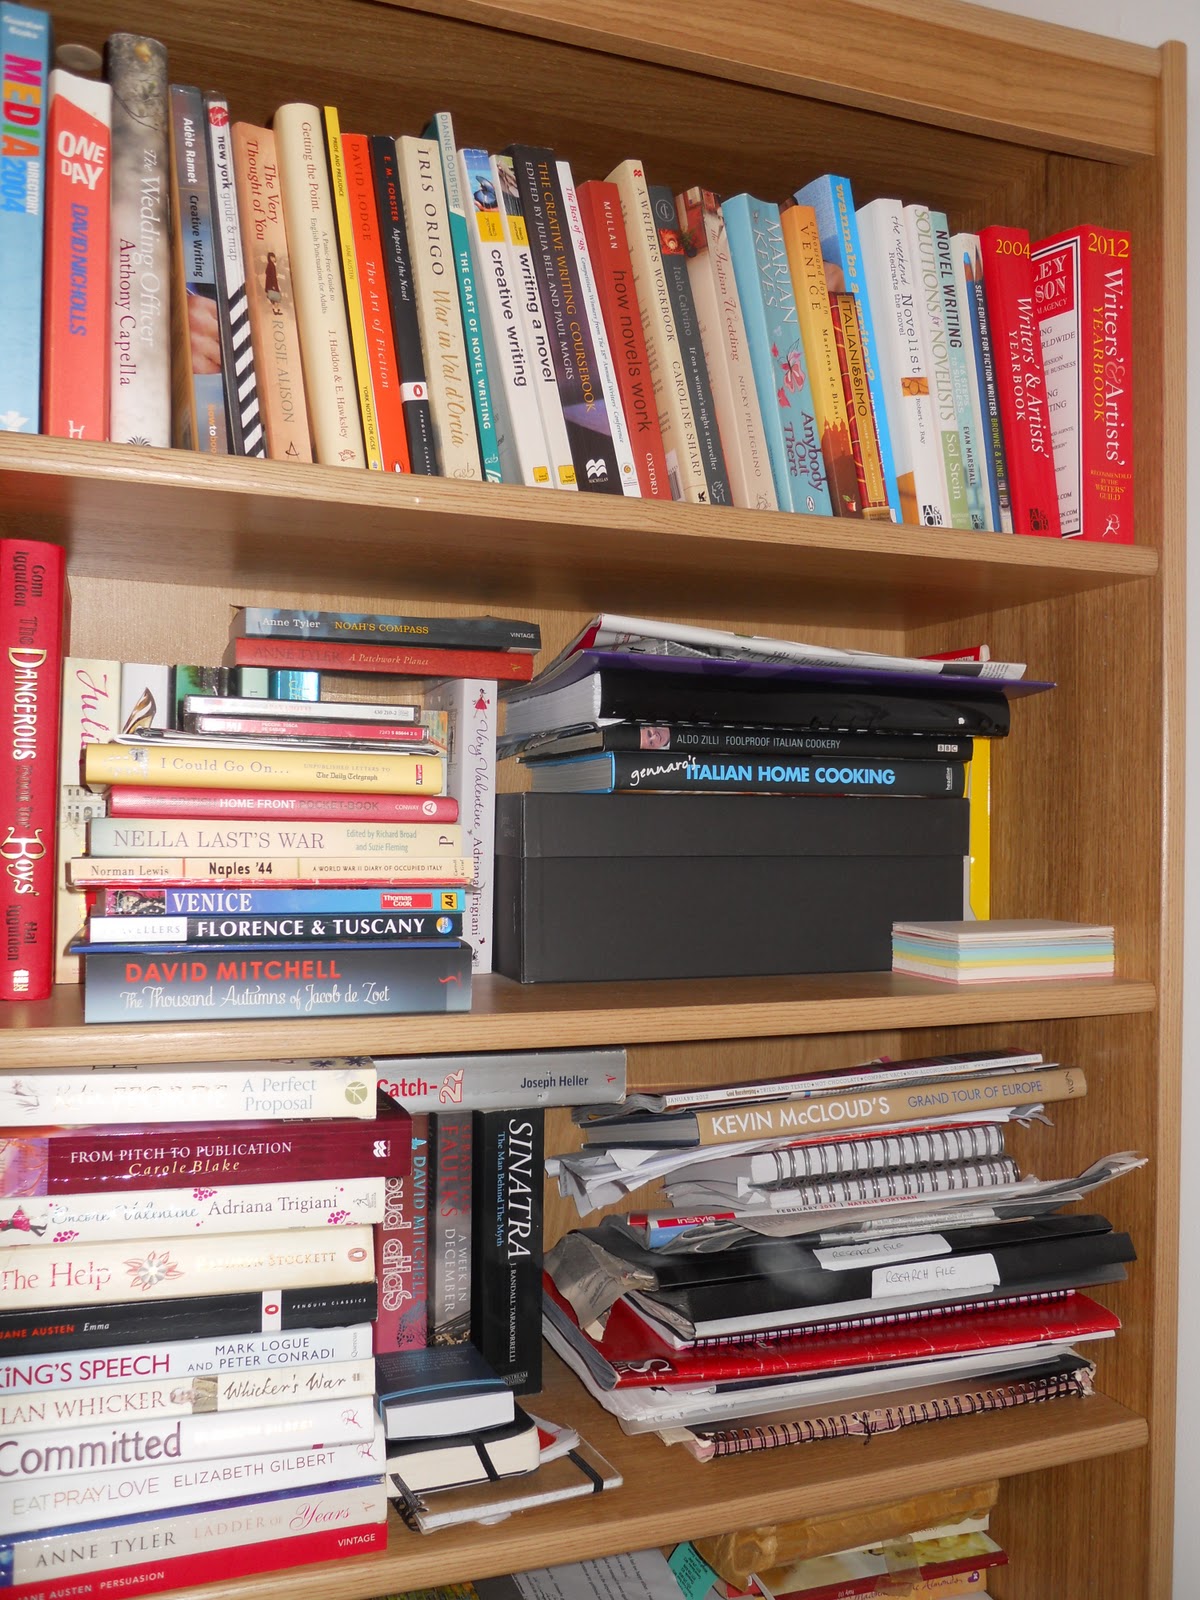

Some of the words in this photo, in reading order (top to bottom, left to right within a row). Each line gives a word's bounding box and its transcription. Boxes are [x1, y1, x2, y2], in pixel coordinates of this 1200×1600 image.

[2, 54, 42, 157] MEDIA
[58, 131, 107, 164] ONE
[440, 114, 452, 151] DIANNE
[446, 155, 461, 209] DOUBTFIRE
[61, 160, 104, 190] DAY
[247, 140, 262, 195] Thought
[306, 162, 316, 180] the
[336, 169, 345, 197] PREJUDICE
[417, 149, 434, 192] IRIS
[217, 136, 226, 160] new
[227, 237, 237, 261] map
[133, 176, 161, 265] Wedding
[603, 201, 618, 249] MULLAN
[835, 184, 857, 278] wannabe
[392, 227, 402, 254] Aspects
[424, 203, 444, 275] ORIGO
[996, 239, 1030, 259] 2004
[1088, 233, 1129, 258] 2012
[115, 239, 136, 311] Anthony
[366, 262, 376, 284] The
[543, 254, 551, 278] BELL
[753, 228, 778, 308] KEYES
[765, 218, 799, 324] MARIAN
[800, 225, 821, 310] VENICE
[369, 291, 379, 311] Art
[544, 191, 563, 252] CREATIVE
[556, 256, 576, 315] WRITING
[569, 321, 596, 413] COURSEBOOK
[612, 270, 627, 310] how
[935, 230, 950, 278] NOVEL
[943, 284, 963, 348] WRITING
[140, 272, 161, 347] Officer
[491, 250, 513, 320] creative
[506, 326, 527, 387] writing
[519, 253, 540, 314] writing
[536, 336, 556, 383] novel
[915, 209, 942, 313] SOLUTIONS
[930, 329, 957, 421] NOVELISTS
[975, 284, 987, 334] SELF-EDITING
[438, 332, 455, 348] in
[459, 251, 469, 273] THE
[471, 337, 484, 375] NOVEL
[478, 379, 491, 430] WRITING
[619, 316, 641, 377] novels
[673, 266, 682, 289] Italo
[701, 405, 710, 429] night
[901, 293, 921, 374] Novelist
[115, 315, 137, 386] Capella
[1093, 307, 1105, 421] YEARBOOK
[654, 268, 676, 342] WORKBOOK
[672, 361, 692, 429] CAROLINE
[686, 433, 702, 477] SHARP
[1008, 331, 1026, 421] YEARBOOK
[1024, 373, 1041, 389] &
[630, 383, 652, 432] work
[783, 421, 798, 477] There
[800, 410, 828, 492] Anybody
[963, 426, 971, 445] EVAN
[645, 452, 659, 495] OXFORD
[950, 464, 962, 500] Stein
[379, 623, 429, 634] COMPASS
[510, 631, 535, 639] VINTAGE
[359, 653, 401, 664] Patchwork
[8, 647, 47, 760] DANGEROUS
[676, 735, 699, 744] ALDO
[701, 735, 720, 745] ZILLI
[726, 736, 770, 746] FOOLPROOF
[773, 737, 803, 748] ITALIAN
[805, 738, 841, 749] COOKERY
[937, 743, 959, 753] BBC
[173, 758, 217, 771] Could
[329, 771, 347, 781] Daily
[687, 765, 752, 782] ITALIAN
[758, 766, 810, 783] HOME
[815, 767, 896, 785] COOKING
[220, 799, 255, 809] HOME
[257, 799, 296, 809] FRONT
[474, 759, 491, 830] Valentine
[114, 830, 188, 848] NELLA
[198, 831, 271, 848] LAST'S
[279, 832, 325, 848] WAR
[346, 829, 365, 838] Edited
[376, 829, 399, 838] Richard
[400, 830, 417, 839] Broad
[368, 843, 384, 852] Suzie
[385, 843, 409, 853] Fleming
[91, 866, 135, 876] Norman
[139, 865, 169, 875] Lewis
[209, 862, 250, 878] Naples
[172, 893, 253, 912] VENICE
[196, 920, 304, 936] FLORENCE
[311, 920, 326, 935] &
[332, 918, 425, 935] TUSCANY
[125, 962, 208, 983] DAVID
[216, 960, 342, 981] MITCHELL
[142, 985, 215, 1010] Thousand
[219, 984, 286, 1006] Autumns
[302, 983, 343, 1012] Jacob
[241, 1079, 254, 1093] A
[262, 1076, 318, 1093] Perfect
[520, 1076, 556, 1089] Joseph
[558, 1075, 589, 1087] Heller
[245, 1094, 314, 1114] Proposal
[712, 1110, 774, 1136] KEVIN
[780, 1097, 890, 1128] McCLOUD'S
[907, 1092, 949, 1108] GRAND
[952, 1088, 986, 1103] TOUR
[987, 1086, 999, 1098] OF
[1003, 1080, 1044, 1096] EUROPE
[71, 1150, 114, 1164] FROM
[119, 1148, 164, 1162] PITCH
[170, 1146, 192, 1159] TO
[196, 1141, 293, 1158] PUBLICATION
[128, 1160, 187, 1177] Carole
[193, 1158, 241, 1174] Blake
[497, 1151, 505, 1171] Man
[412, 1156, 427, 1209] DAVID
[497, 1173, 505, 1203] Behind
[507, 1119, 533, 1260] SINATRA
[207, 1200, 273, 1216] Adriana
[277, 1194, 338, 1213] Trigiani
[495, 1223, 505, 1247] Myth
[2, 1270, 40, 1292] The
[50, 1261, 113, 1292] Help
[444, 1227, 457, 1313] DECEMBER
[31, 1324, 76, 1337] AUSTEN
[83, 1322, 111, 1332] Emma
[215, 1342, 255, 1356] MARK
[261, 1337, 310, 1352] LOGUE
[219, 1355, 261, 1370] PETER
[267, 1348, 335, 1364] CONRADI
[79, 1353, 171, 1386] SPEECH
[54, 1390, 167, 1419] WHICKER
[0, 1421, 183, 1477] Committed
[174, 1463, 264, 1488] ELIZABETH
[270, 1451, 336, 1472] GILBERT
[35, 1545, 99, 1568] ANNE
[111, 1531, 176, 1555] TYLER
[289, 1500, 351, 1531] Years
[338, 1533, 376, 1547] VINTAGE
[100, 1571, 165, 1590] PERSUASION
